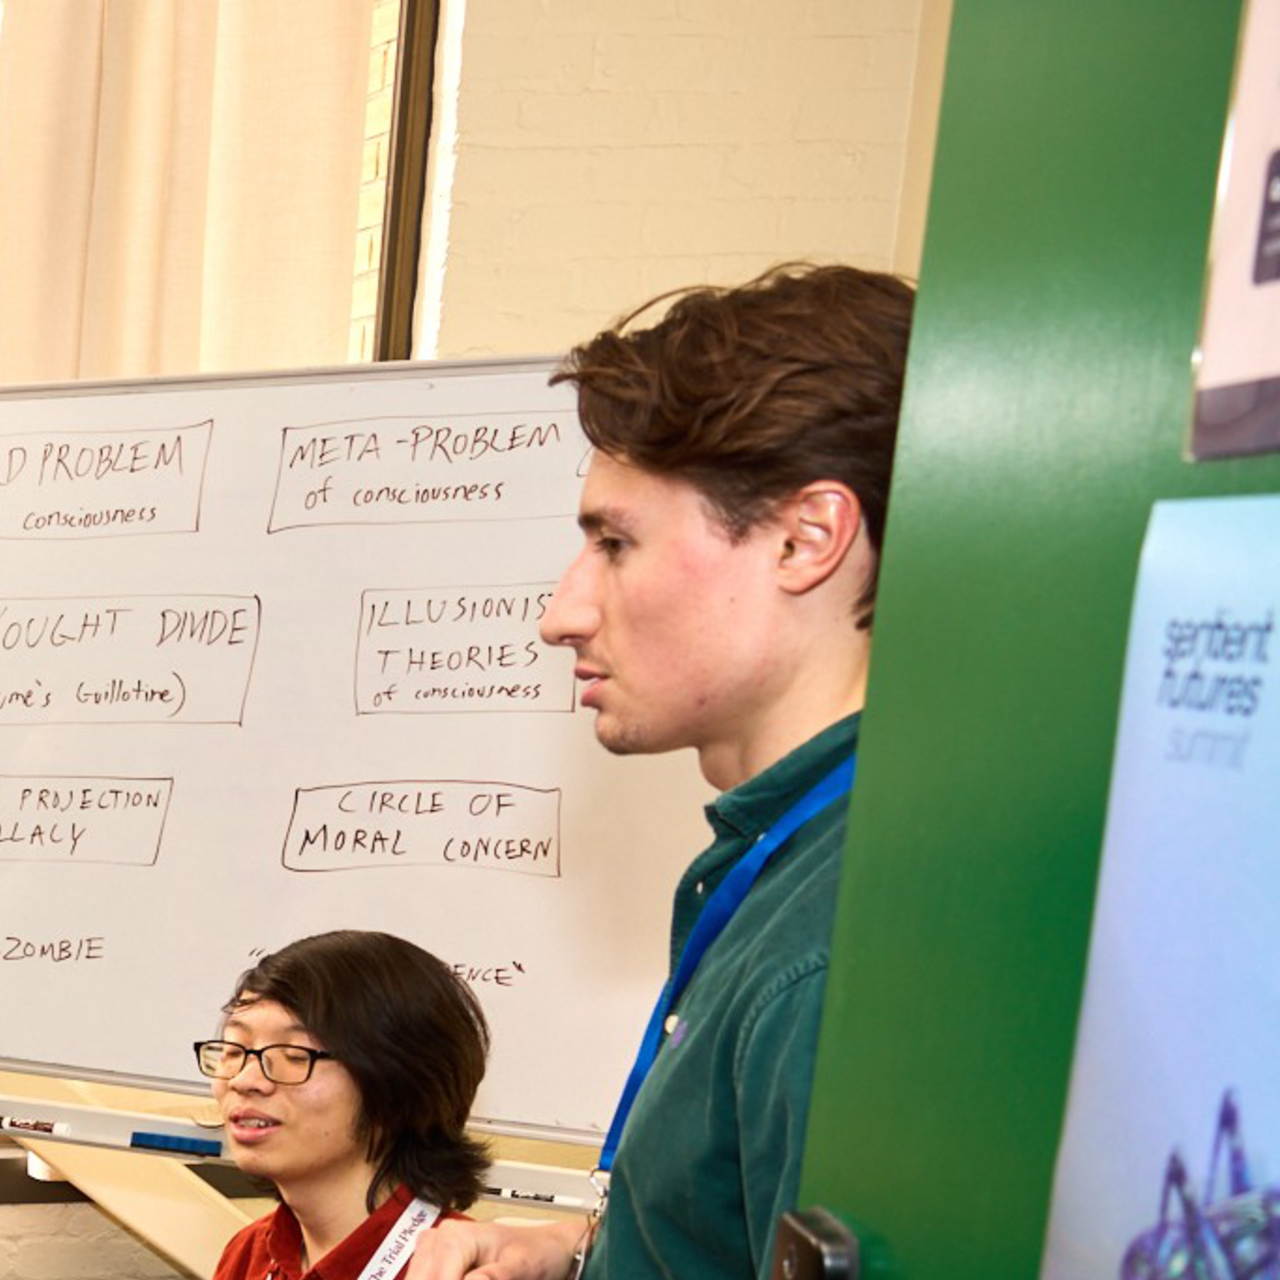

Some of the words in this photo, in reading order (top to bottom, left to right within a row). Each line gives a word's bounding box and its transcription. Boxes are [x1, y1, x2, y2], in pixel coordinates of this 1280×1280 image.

[38, 435, 184, 487] PROBLEM
[304, 475, 333, 511] of
[352, 481, 505, 507] consciousness
[22, 506, 157, 532] consciousness
[366, 592, 554, 637] ILLUSIONIS
[377, 640, 539, 675] THEORIES
[373, 683, 398, 708] of
[414, 682, 542, 700] consciousness
[18, 787, 162, 813] PROJECTION
[338, 790, 445, 816] CIRCLE
[468, 793, 516, 818] OF
[297, 823, 407, 857] MORAL
[442, 836, 554, 862] CONCERN
[381, 1242, 406, 1266] Trial
[397, 1208, 429, 1243] Pledge
